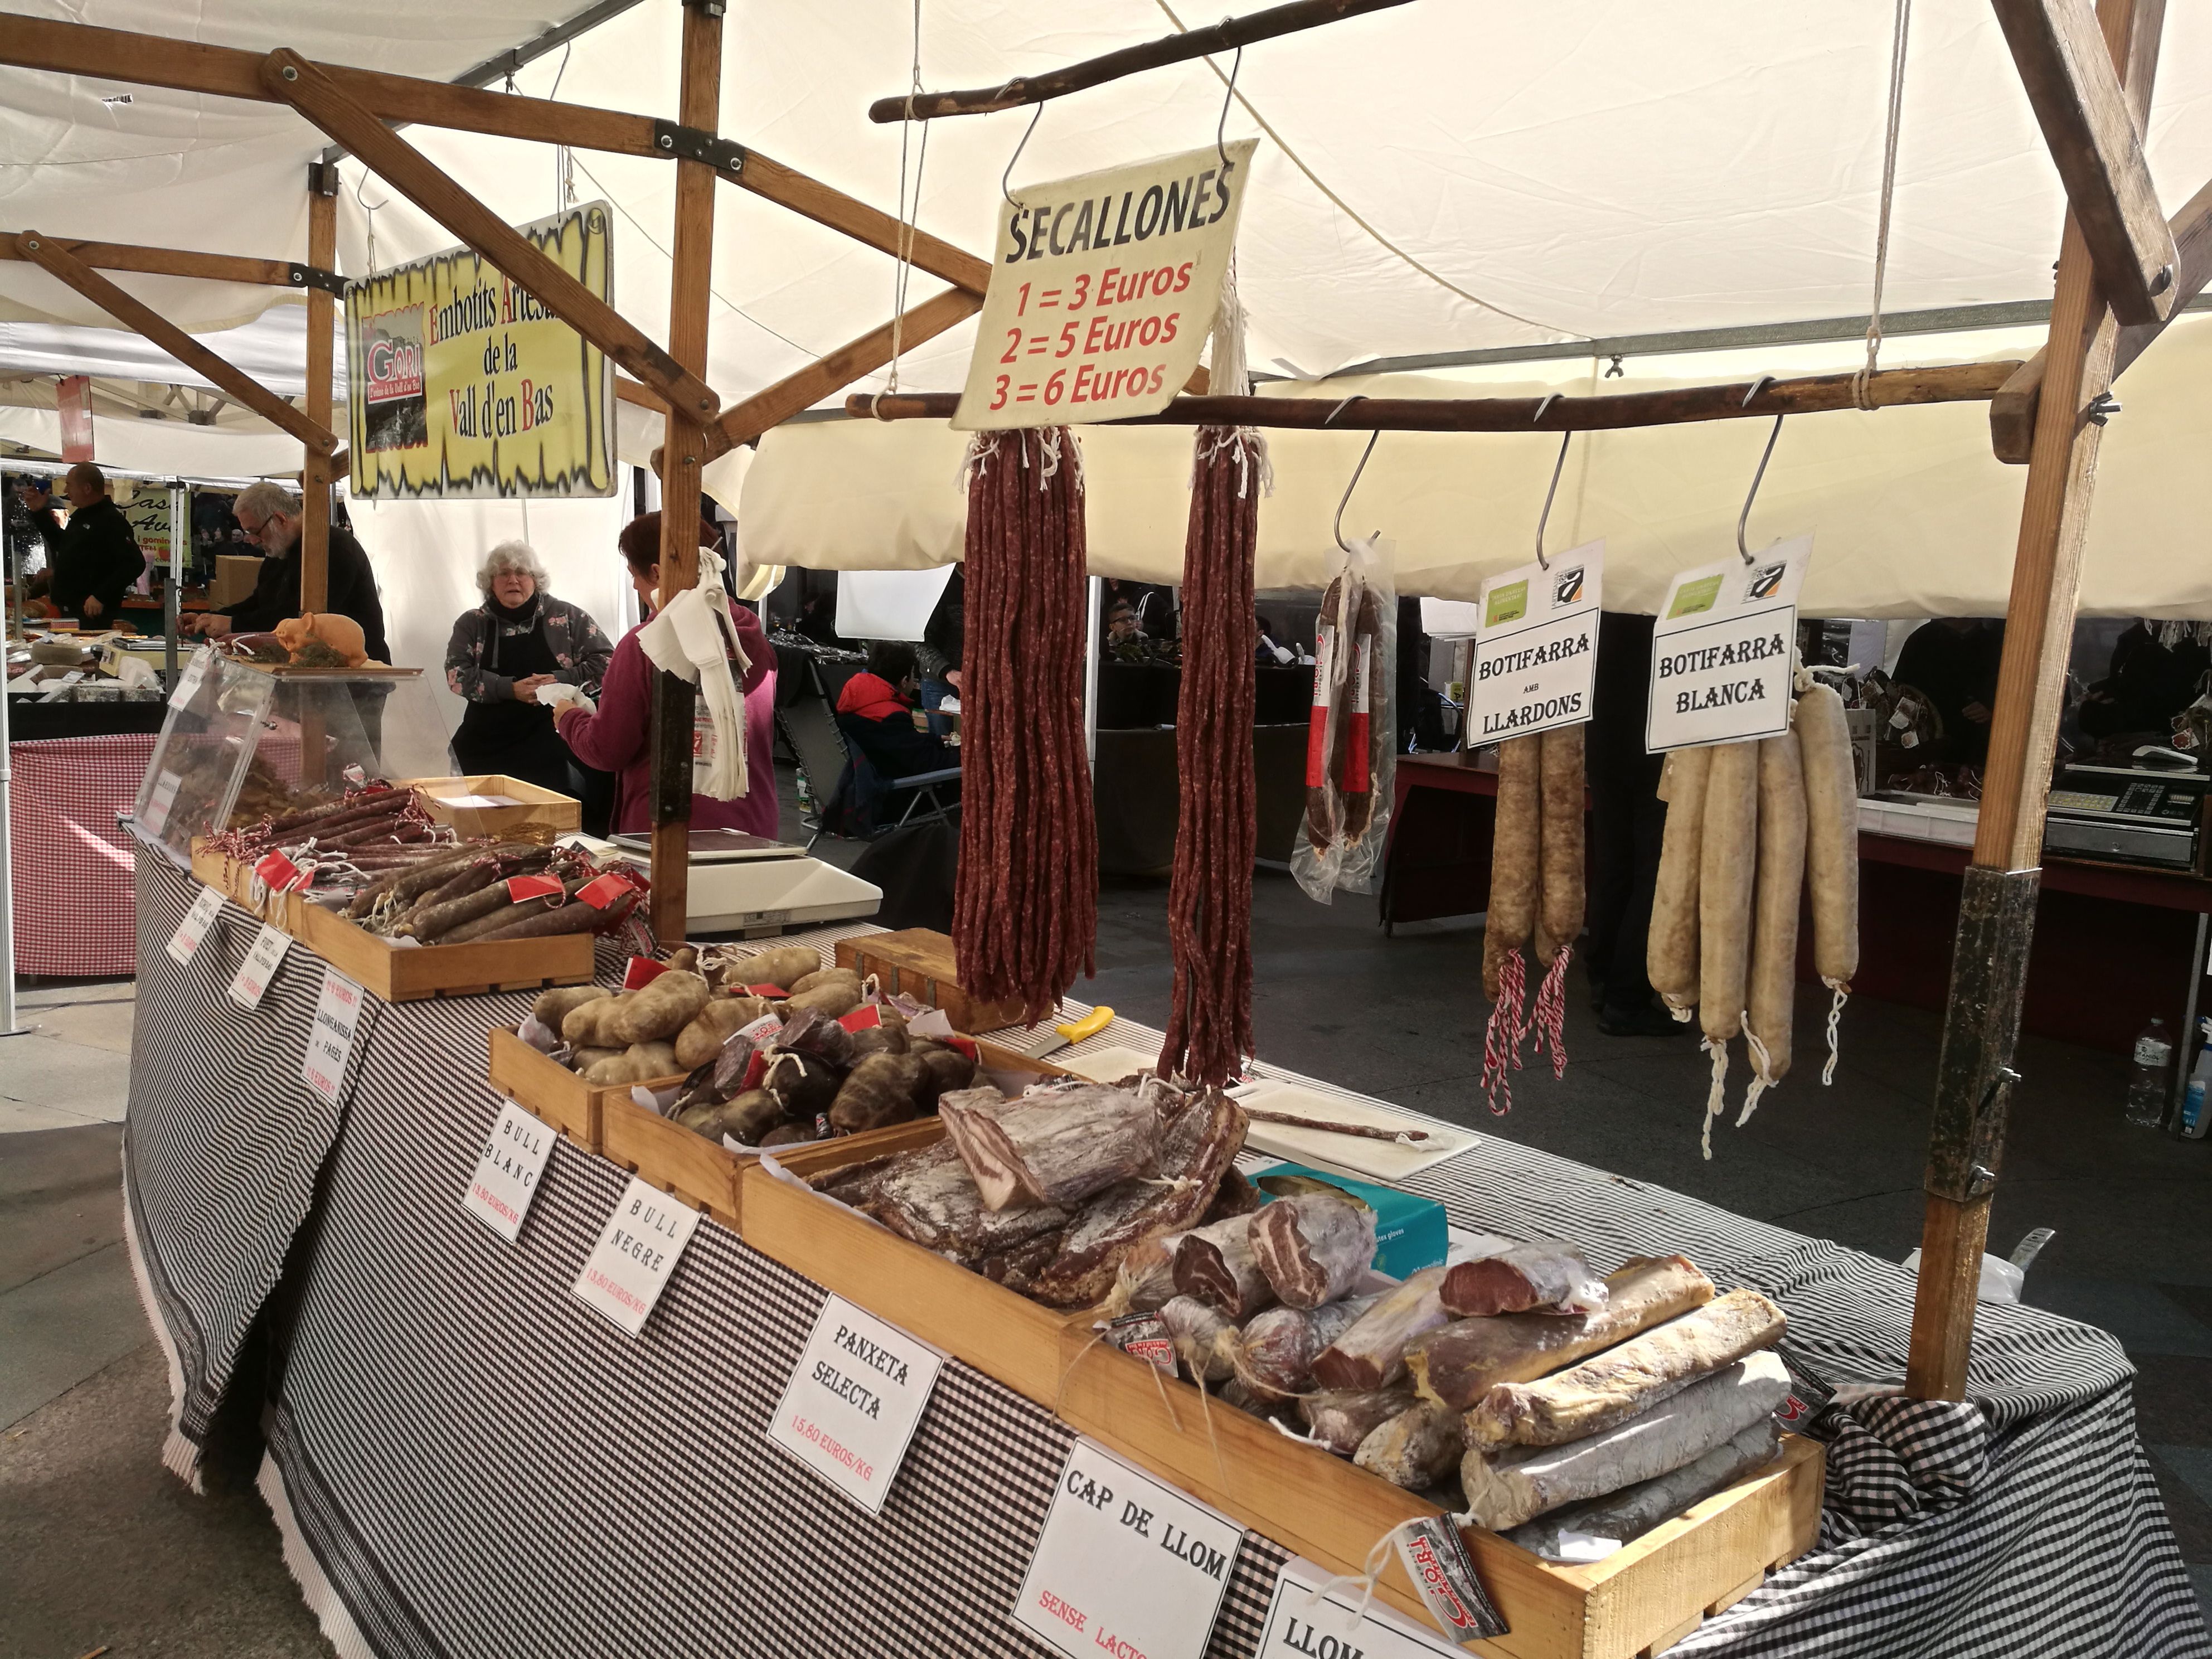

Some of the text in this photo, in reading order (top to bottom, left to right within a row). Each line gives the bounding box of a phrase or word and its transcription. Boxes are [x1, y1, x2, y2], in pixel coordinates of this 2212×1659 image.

[1006, 162, 1234, 263] SECALLONES
[1017, 282, 1031, 316] 1
[1068, 274, 1091, 311] 3
[1096, 261, 1193, 307] Euros
[430, 278, 496, 346] Embotits
[484, 332, 517, 376] de la
[1000, 328, 1022, 364] 2
[1055, 321, 1080, 358] 5
[1083, 312, 1180, 355] Euros
[450, 379, 553, 438] Vall d'en Bas
[989, 374, 1010, 411] 3
[1044, 368, 1066, 406] 6
[1070, 363, 1166, 404] Euros
[1479, 633, 1589, 680] BOTIFARRA
[1660, 634, 1785, 679] BOTIFARRA
[1523, 683, 1539, 695] AMB
[1676, 678, 1765, 714] BLANCA
[1483, 693, 1581, 734] LLARDONS
[336, 985, 353, 1005] EUROS
[317, 1009, 352, 1042] LLONGANISSA
[314, 1071, 331, 1092] EUROS
[503, 1119, 539, 1156] BULL
[484, 1143, 533, 1187] BLANC
[630, 1199, 676, 1239] BULL
[1388, 1228, 1404, 1240] gloves
[611, 1229, 664, 1272] NEGRE
[833, 1325, 909, 1387] PANXETA
[812, 1361, 881, 1420] SELECTA
[819, 1434, 874, 1482] EUROS/KG
[1067, 1470, 1227, 1582] CAP DE LLOM
[1409, 1536, 1467, 1628] GORI
[1039, 1590, 1088, 1633] SENSE
